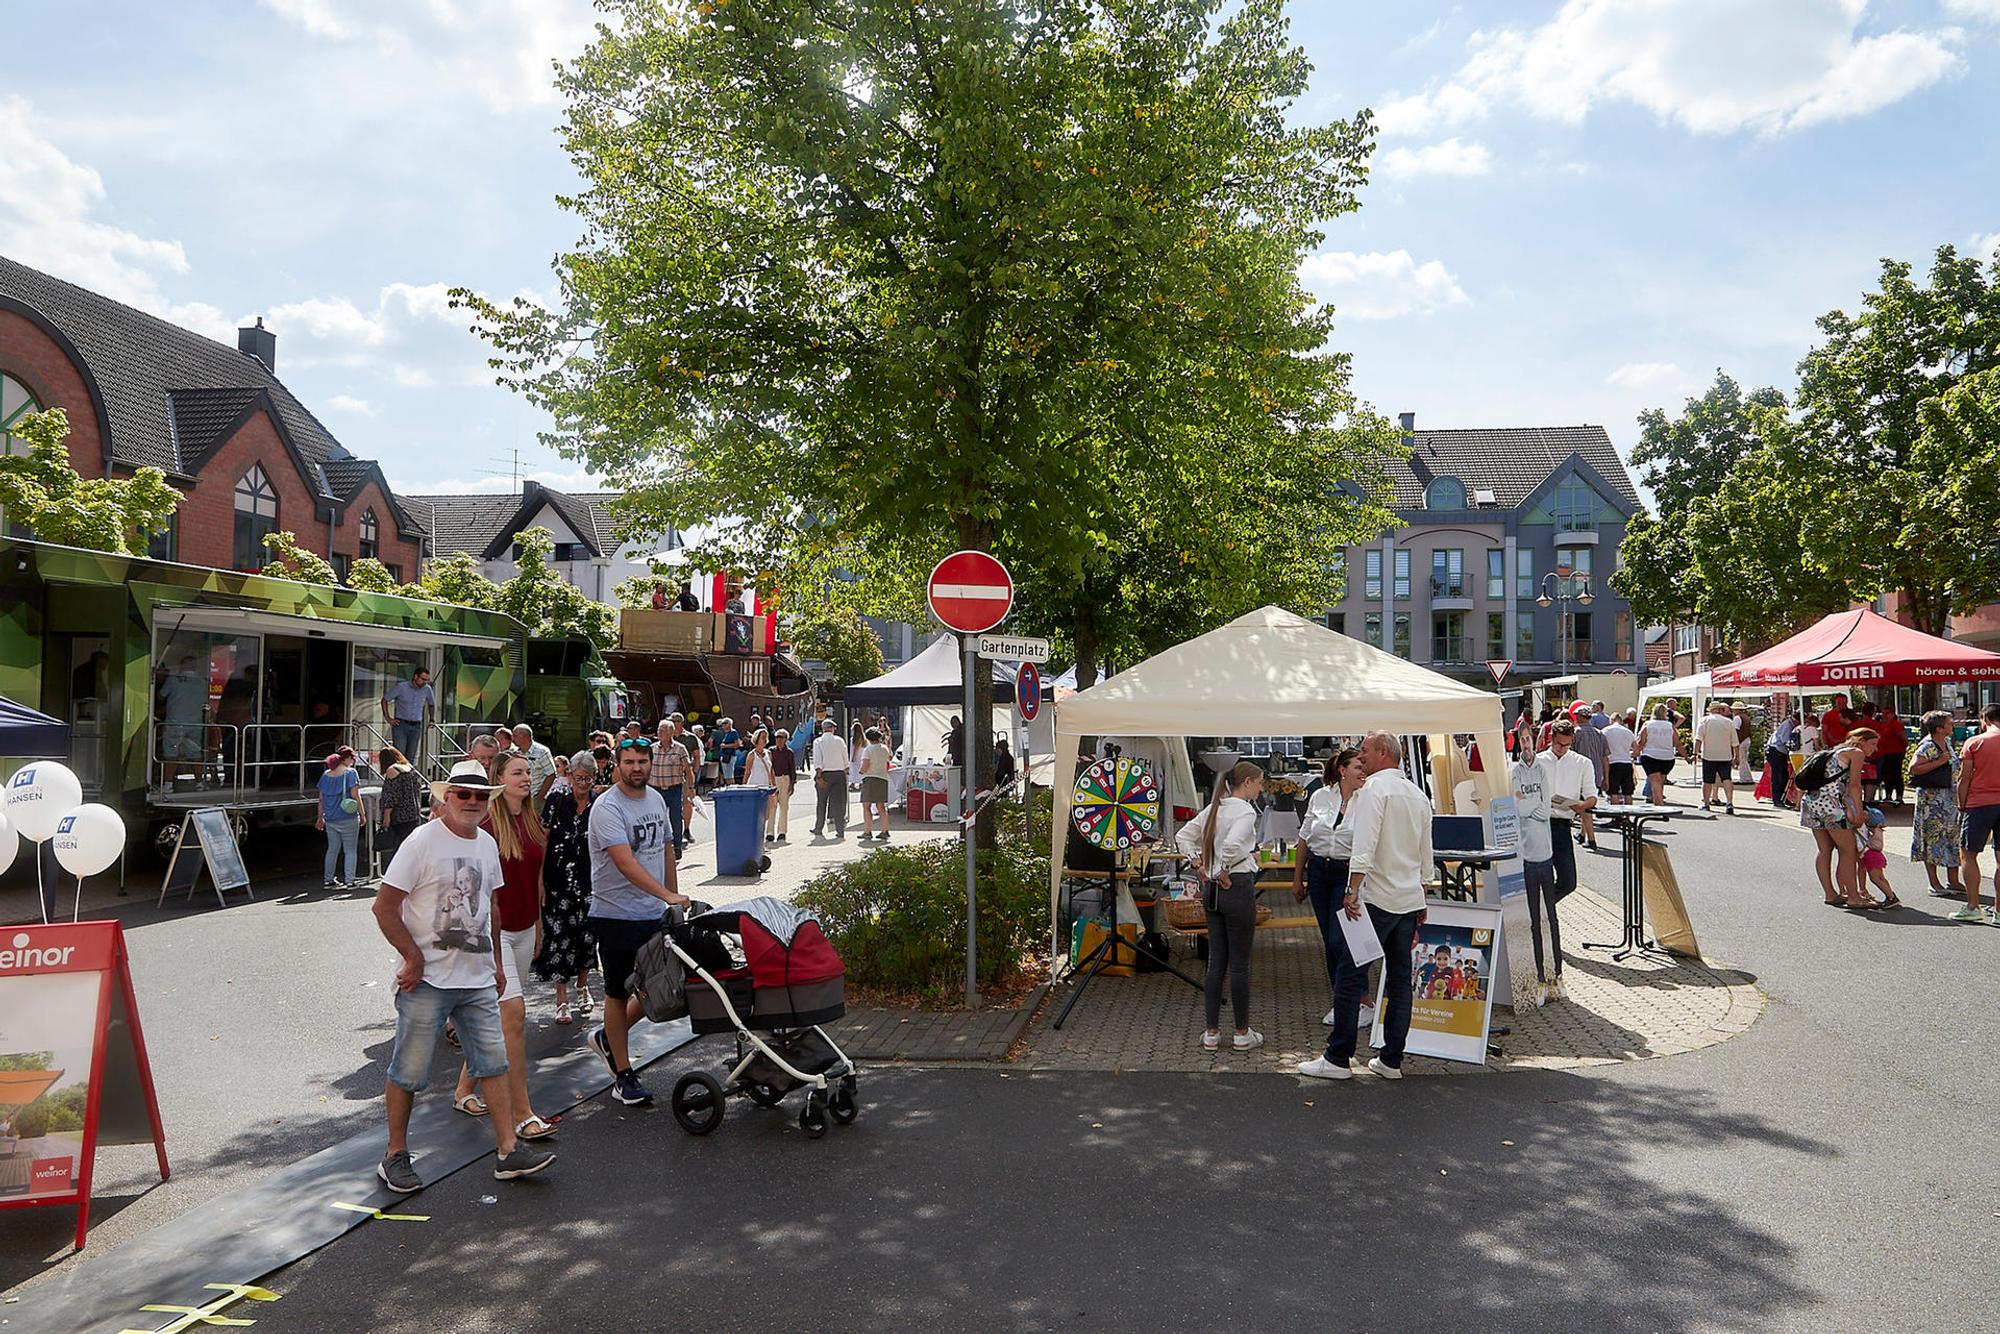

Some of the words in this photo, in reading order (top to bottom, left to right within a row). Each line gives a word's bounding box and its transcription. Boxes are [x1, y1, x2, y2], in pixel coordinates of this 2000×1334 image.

[981, 639, 1044, 658] Gartenplatz
[1915, 667, 1954, 676] hören
[1957, 667, 1967, 676] &
[1971, 666, 2000, 675] sehe
[8, 792, 43, 805] HANSEN
[0, 933, 75, 969] einor
[36, 1165, 68, 1178] weinor
